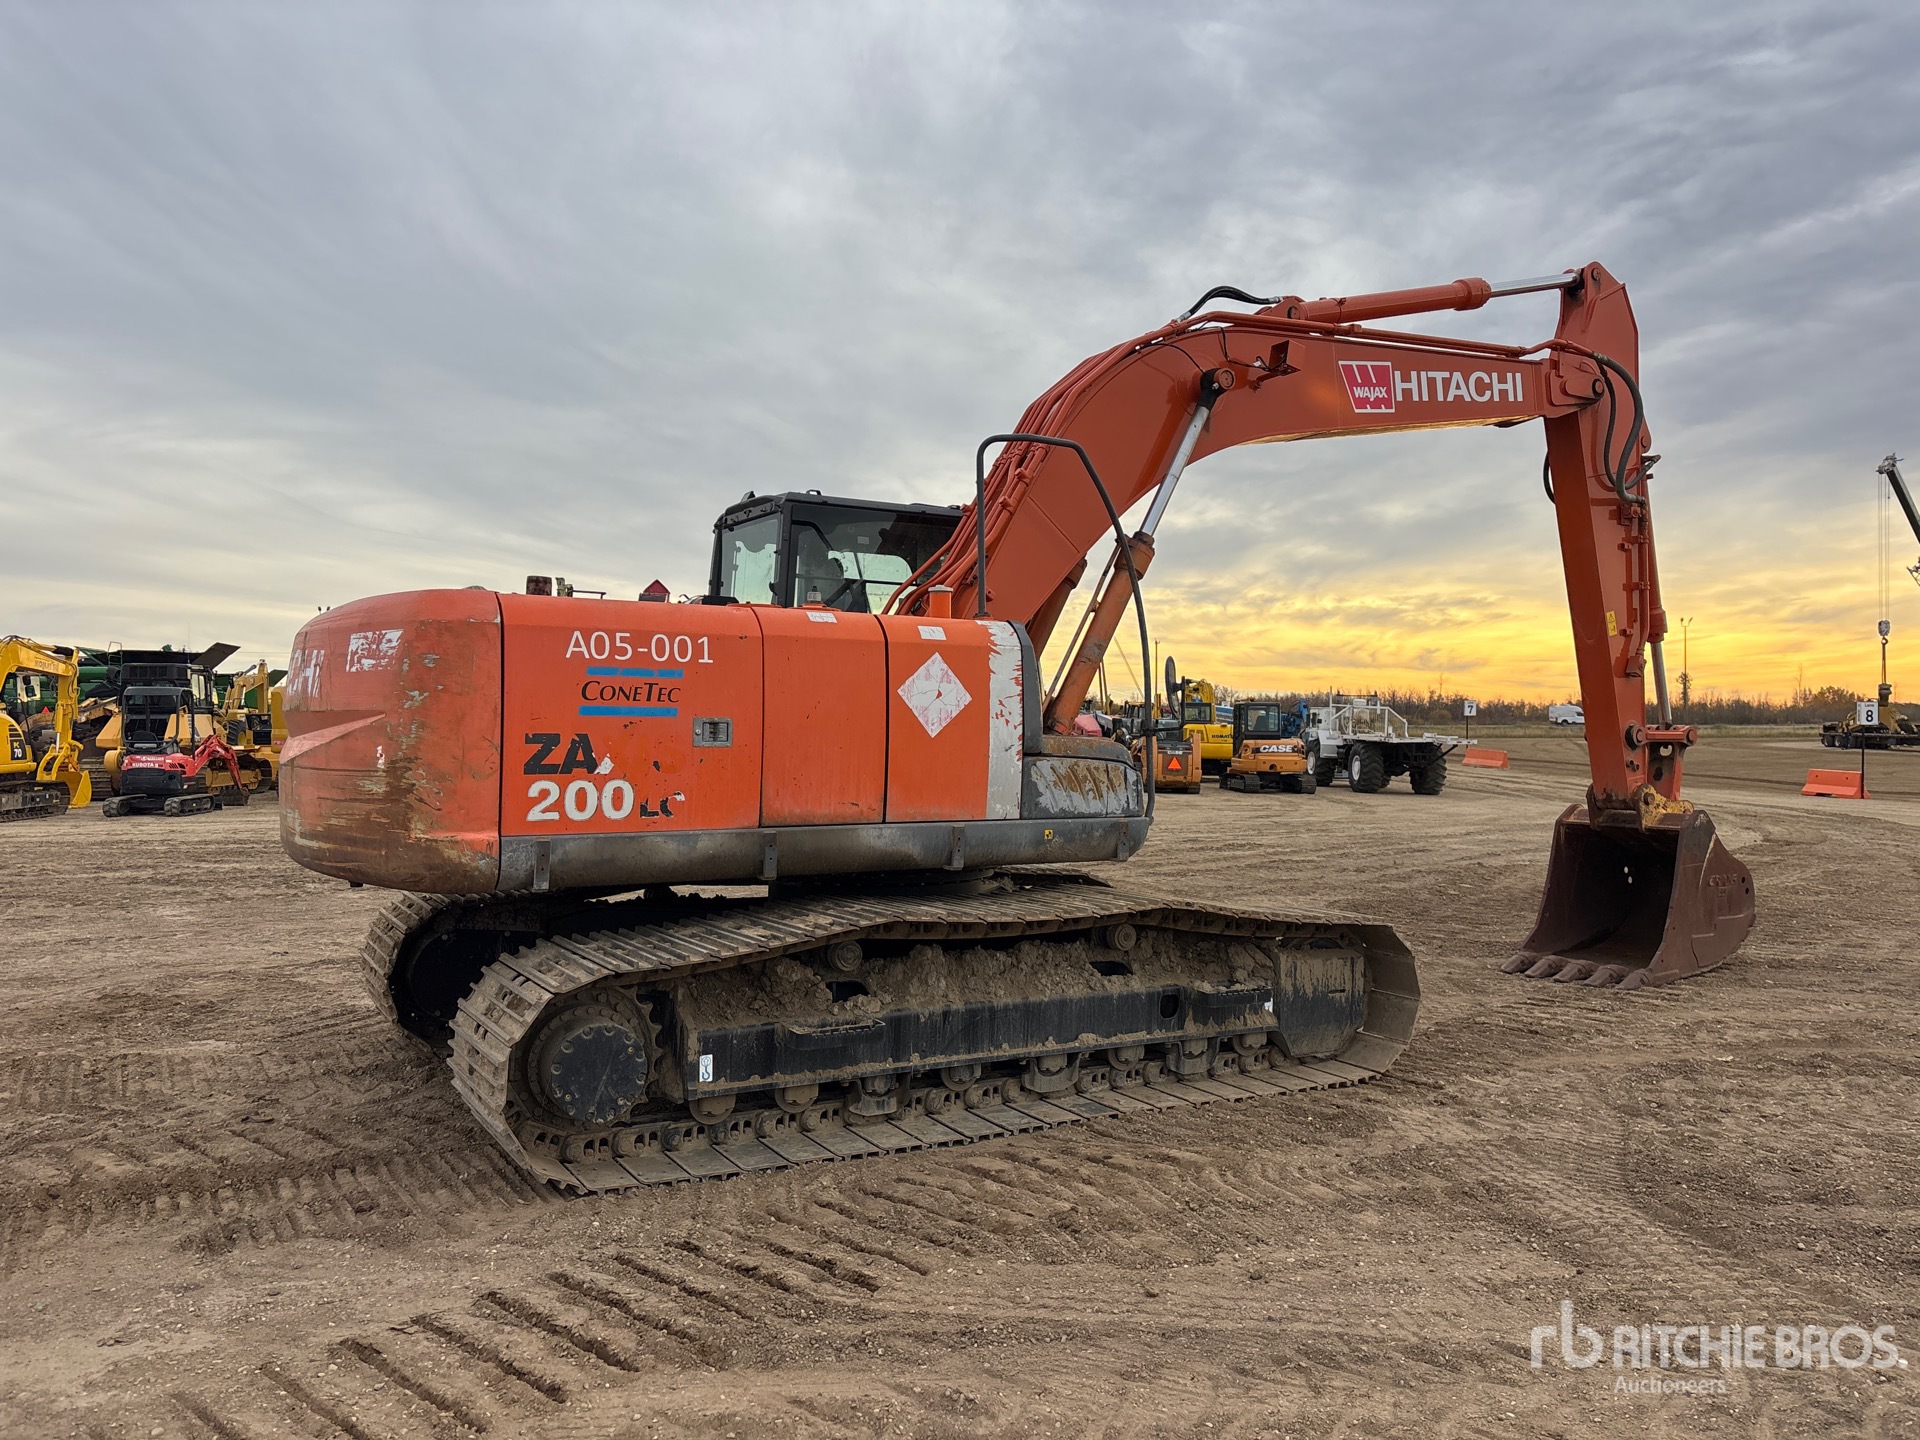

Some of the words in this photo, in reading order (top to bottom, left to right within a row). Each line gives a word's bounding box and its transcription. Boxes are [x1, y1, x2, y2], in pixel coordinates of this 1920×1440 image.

[1394, 370, 1523, 402] HITACHI
[1353, 386, 1388, 402] WAJAX
[565, 630, 714, 663] A05-001
[1467, 705, 1474, 714] 7
[1865, 709, 1874, 723] 8
[13, 748, 23, 758] 70
[1260, 744, 1293, 753] CASE
